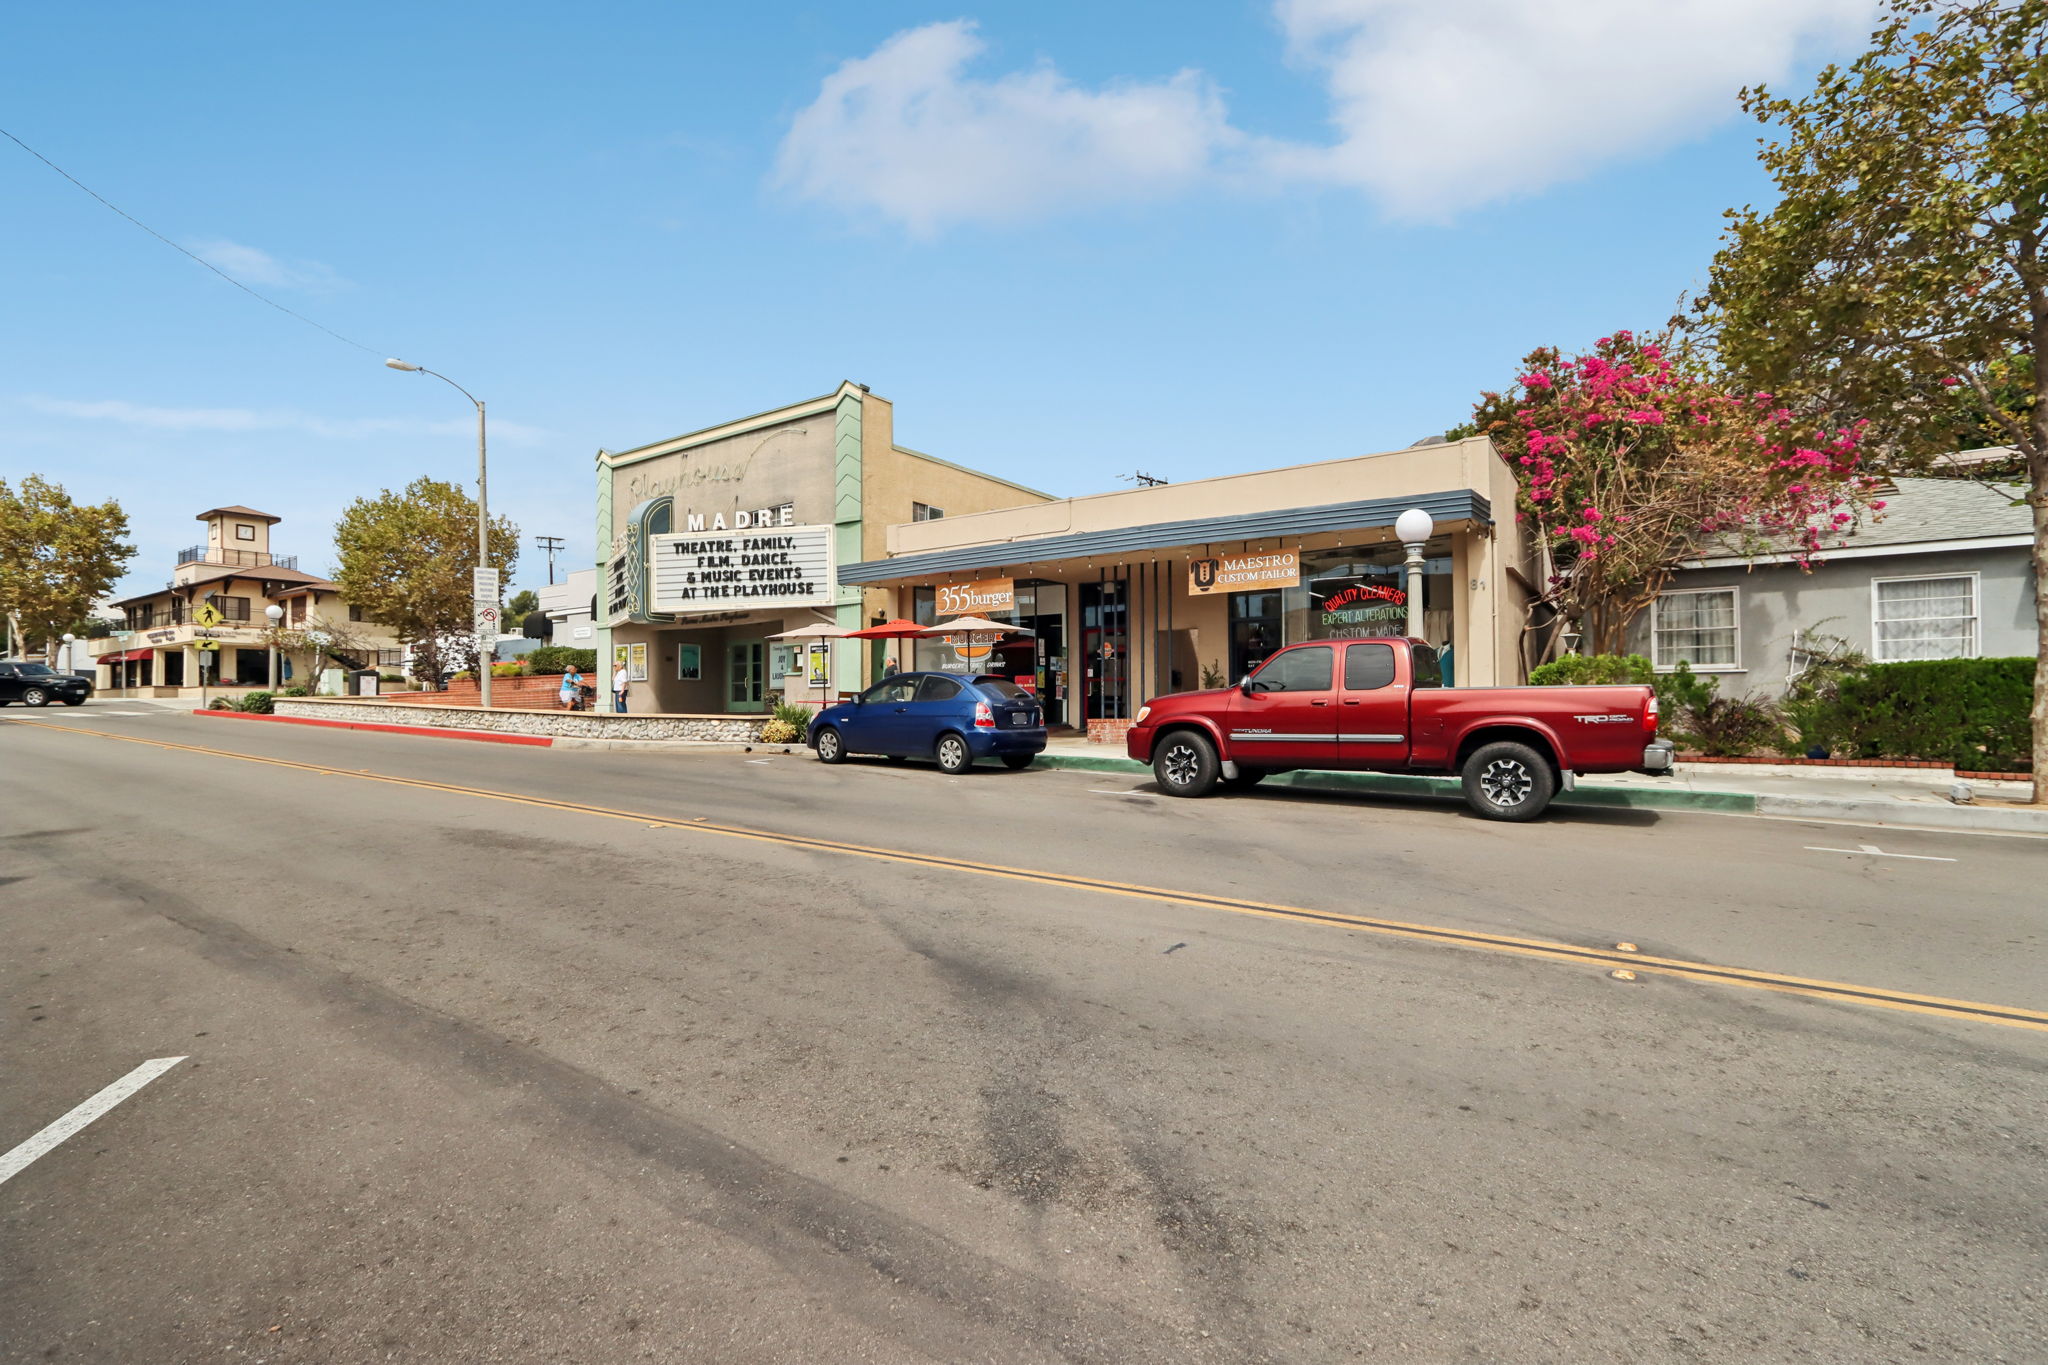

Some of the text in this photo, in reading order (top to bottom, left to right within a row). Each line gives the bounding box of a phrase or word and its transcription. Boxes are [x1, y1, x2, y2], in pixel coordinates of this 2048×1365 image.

[687, 506, 795, 532] MADRE
[1224, 554, 1294, 571] MAESTRO
[687, 567, 802, 584] & MUSIC EVENTS
[1218, 568, 1296, 584] CUSTOM TAILOR
[682, 583, 814, 599] AT THE PLAYHOUSE
[1324, 585, 1406, 612] QUALITY CLEANERS
[1322, 606, 1409, 625] EXPERT ALTERATIONS
[1573, 714, 1608, 724] TRD
